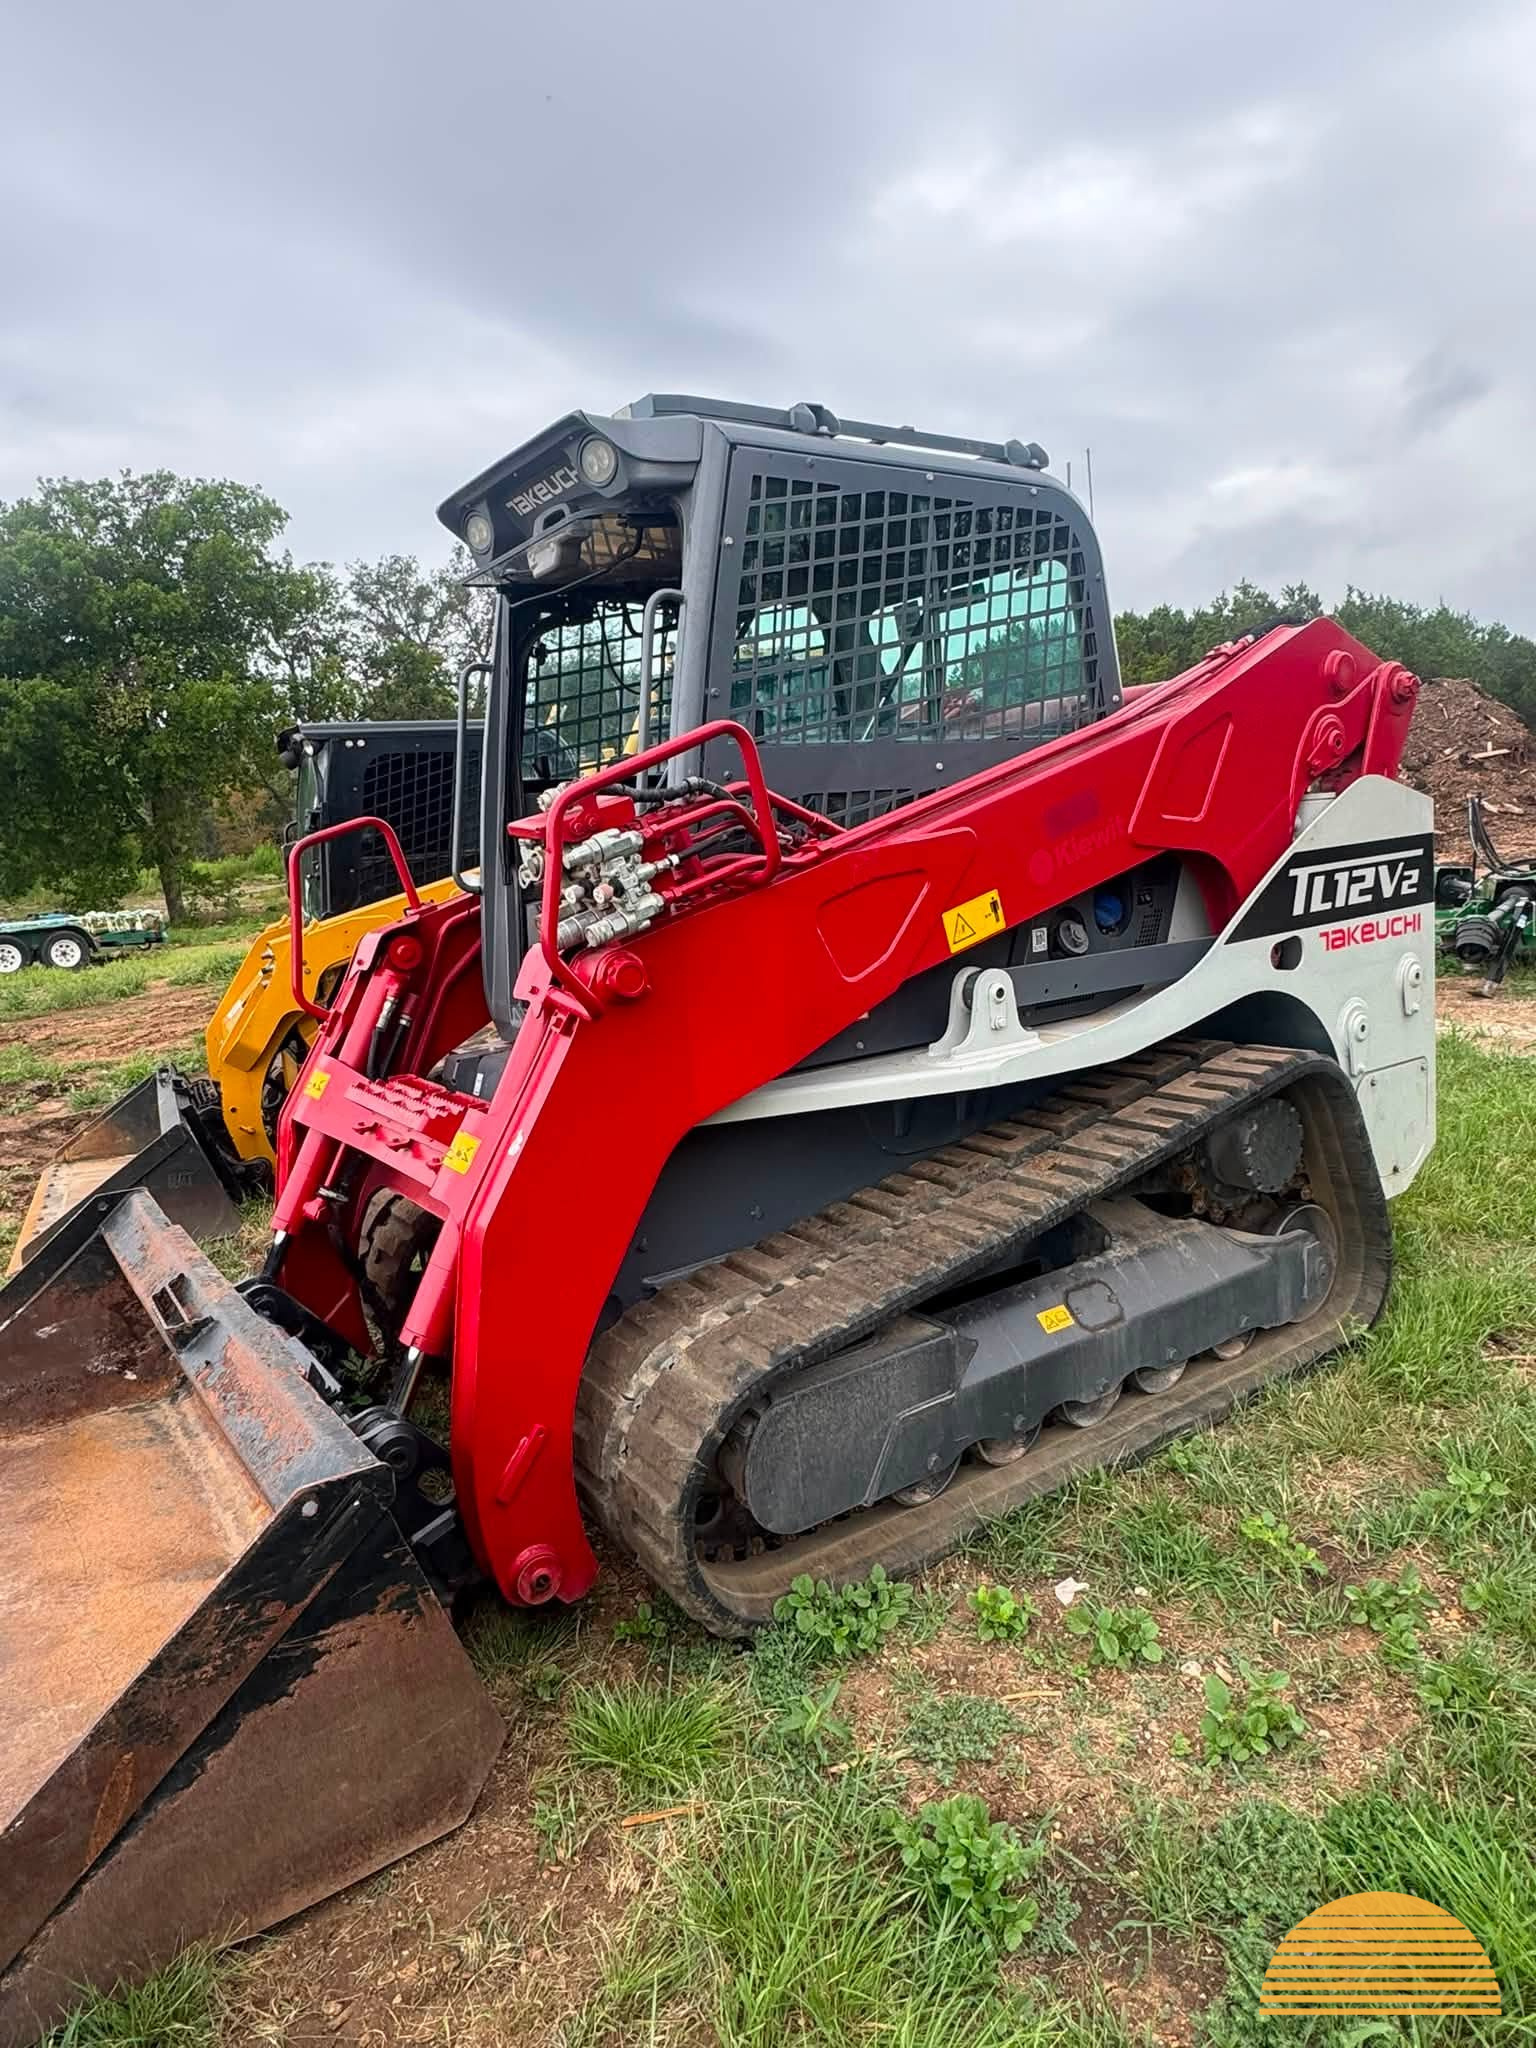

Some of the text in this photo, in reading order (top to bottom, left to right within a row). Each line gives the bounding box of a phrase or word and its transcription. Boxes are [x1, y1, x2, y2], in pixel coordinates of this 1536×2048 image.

[505, 466, 578, 516] TAKEUCH
[1288, 848, 1424, 916] TL12V2
[1319, 912, 1421, 951] TAKEUCHI
